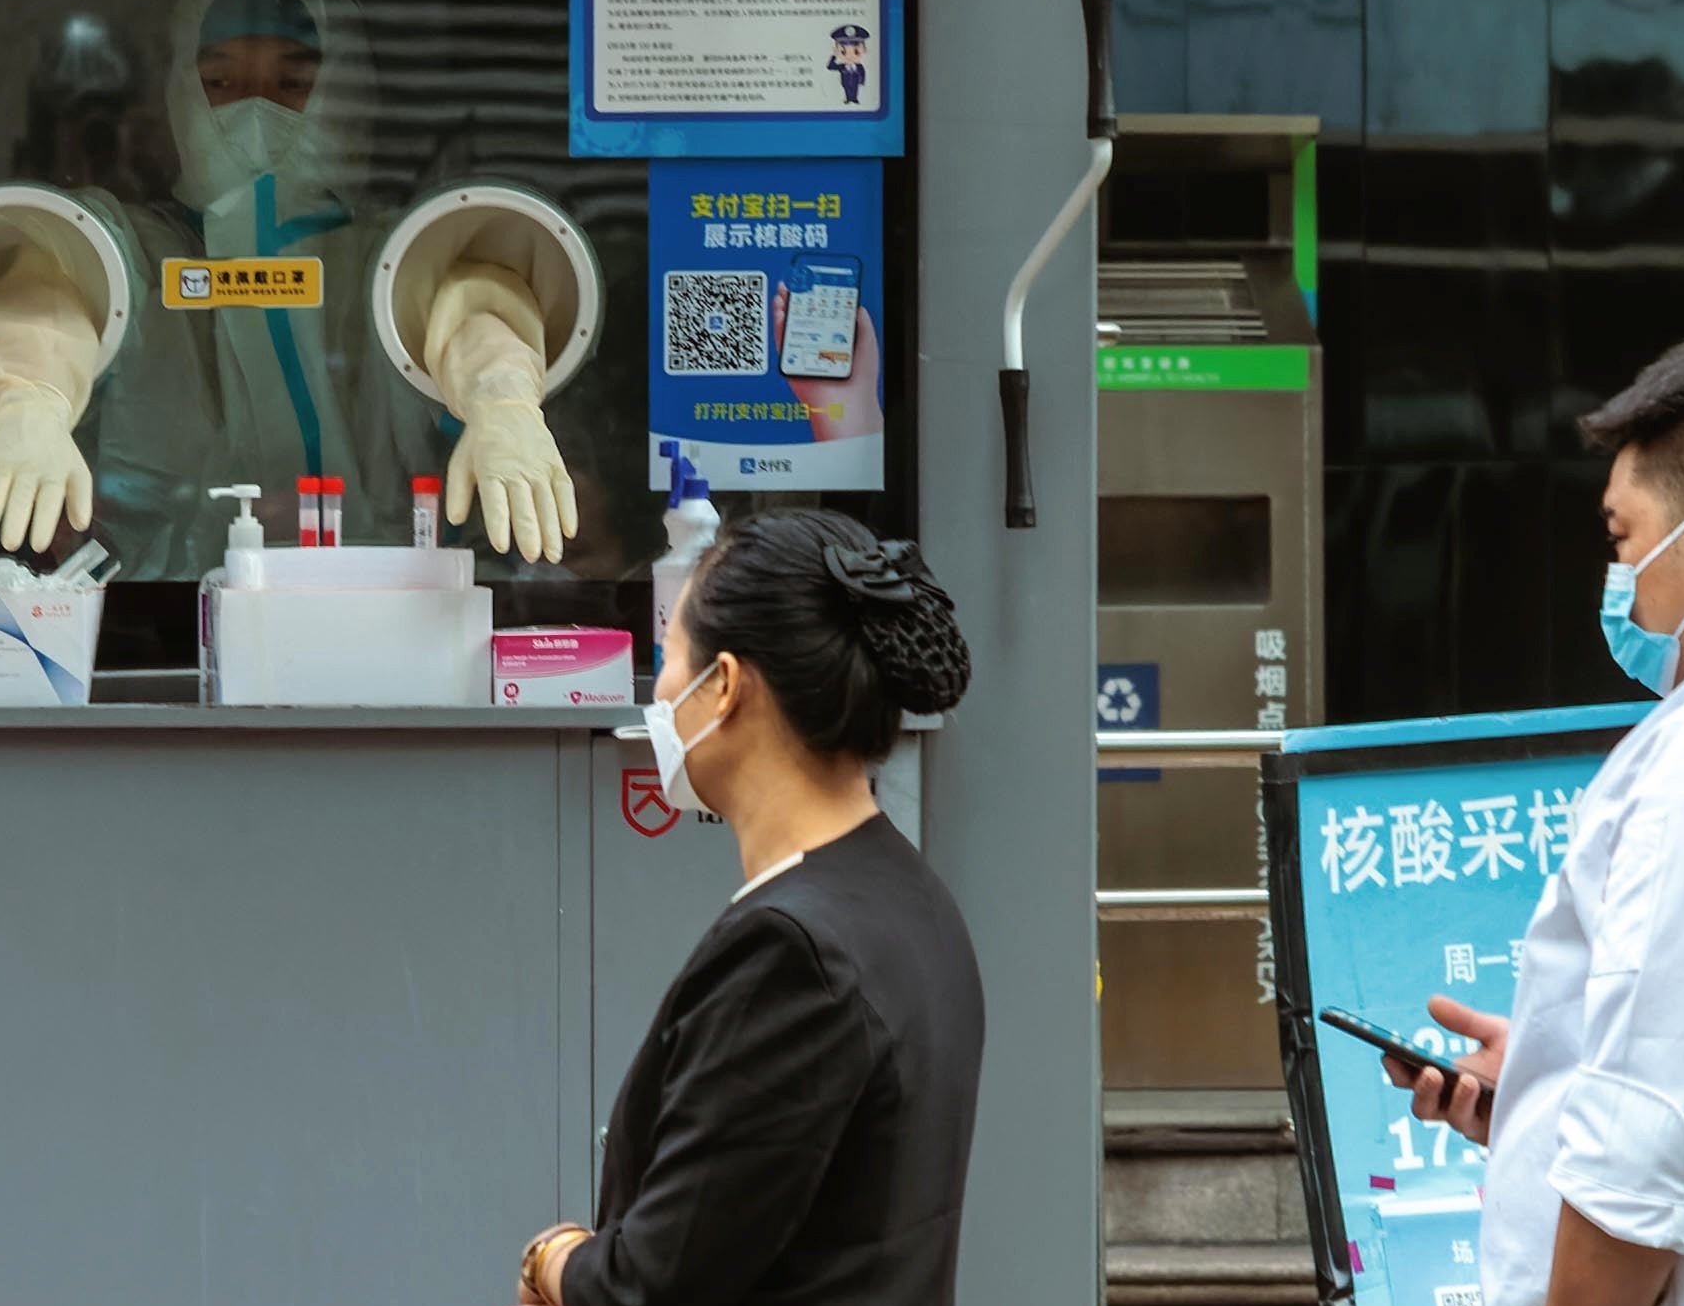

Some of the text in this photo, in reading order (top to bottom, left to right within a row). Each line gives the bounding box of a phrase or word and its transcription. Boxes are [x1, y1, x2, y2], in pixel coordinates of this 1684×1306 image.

[690, 193, 841, 218] 支付宝扫一扫
[703, 224, 829, 248] 展示核酸码
[217, 271, 306, 285] 请佩戴口罩
[757, 459, 792, 473] 支付宝
[1320, 787, 1583, 895] 核酸采样
